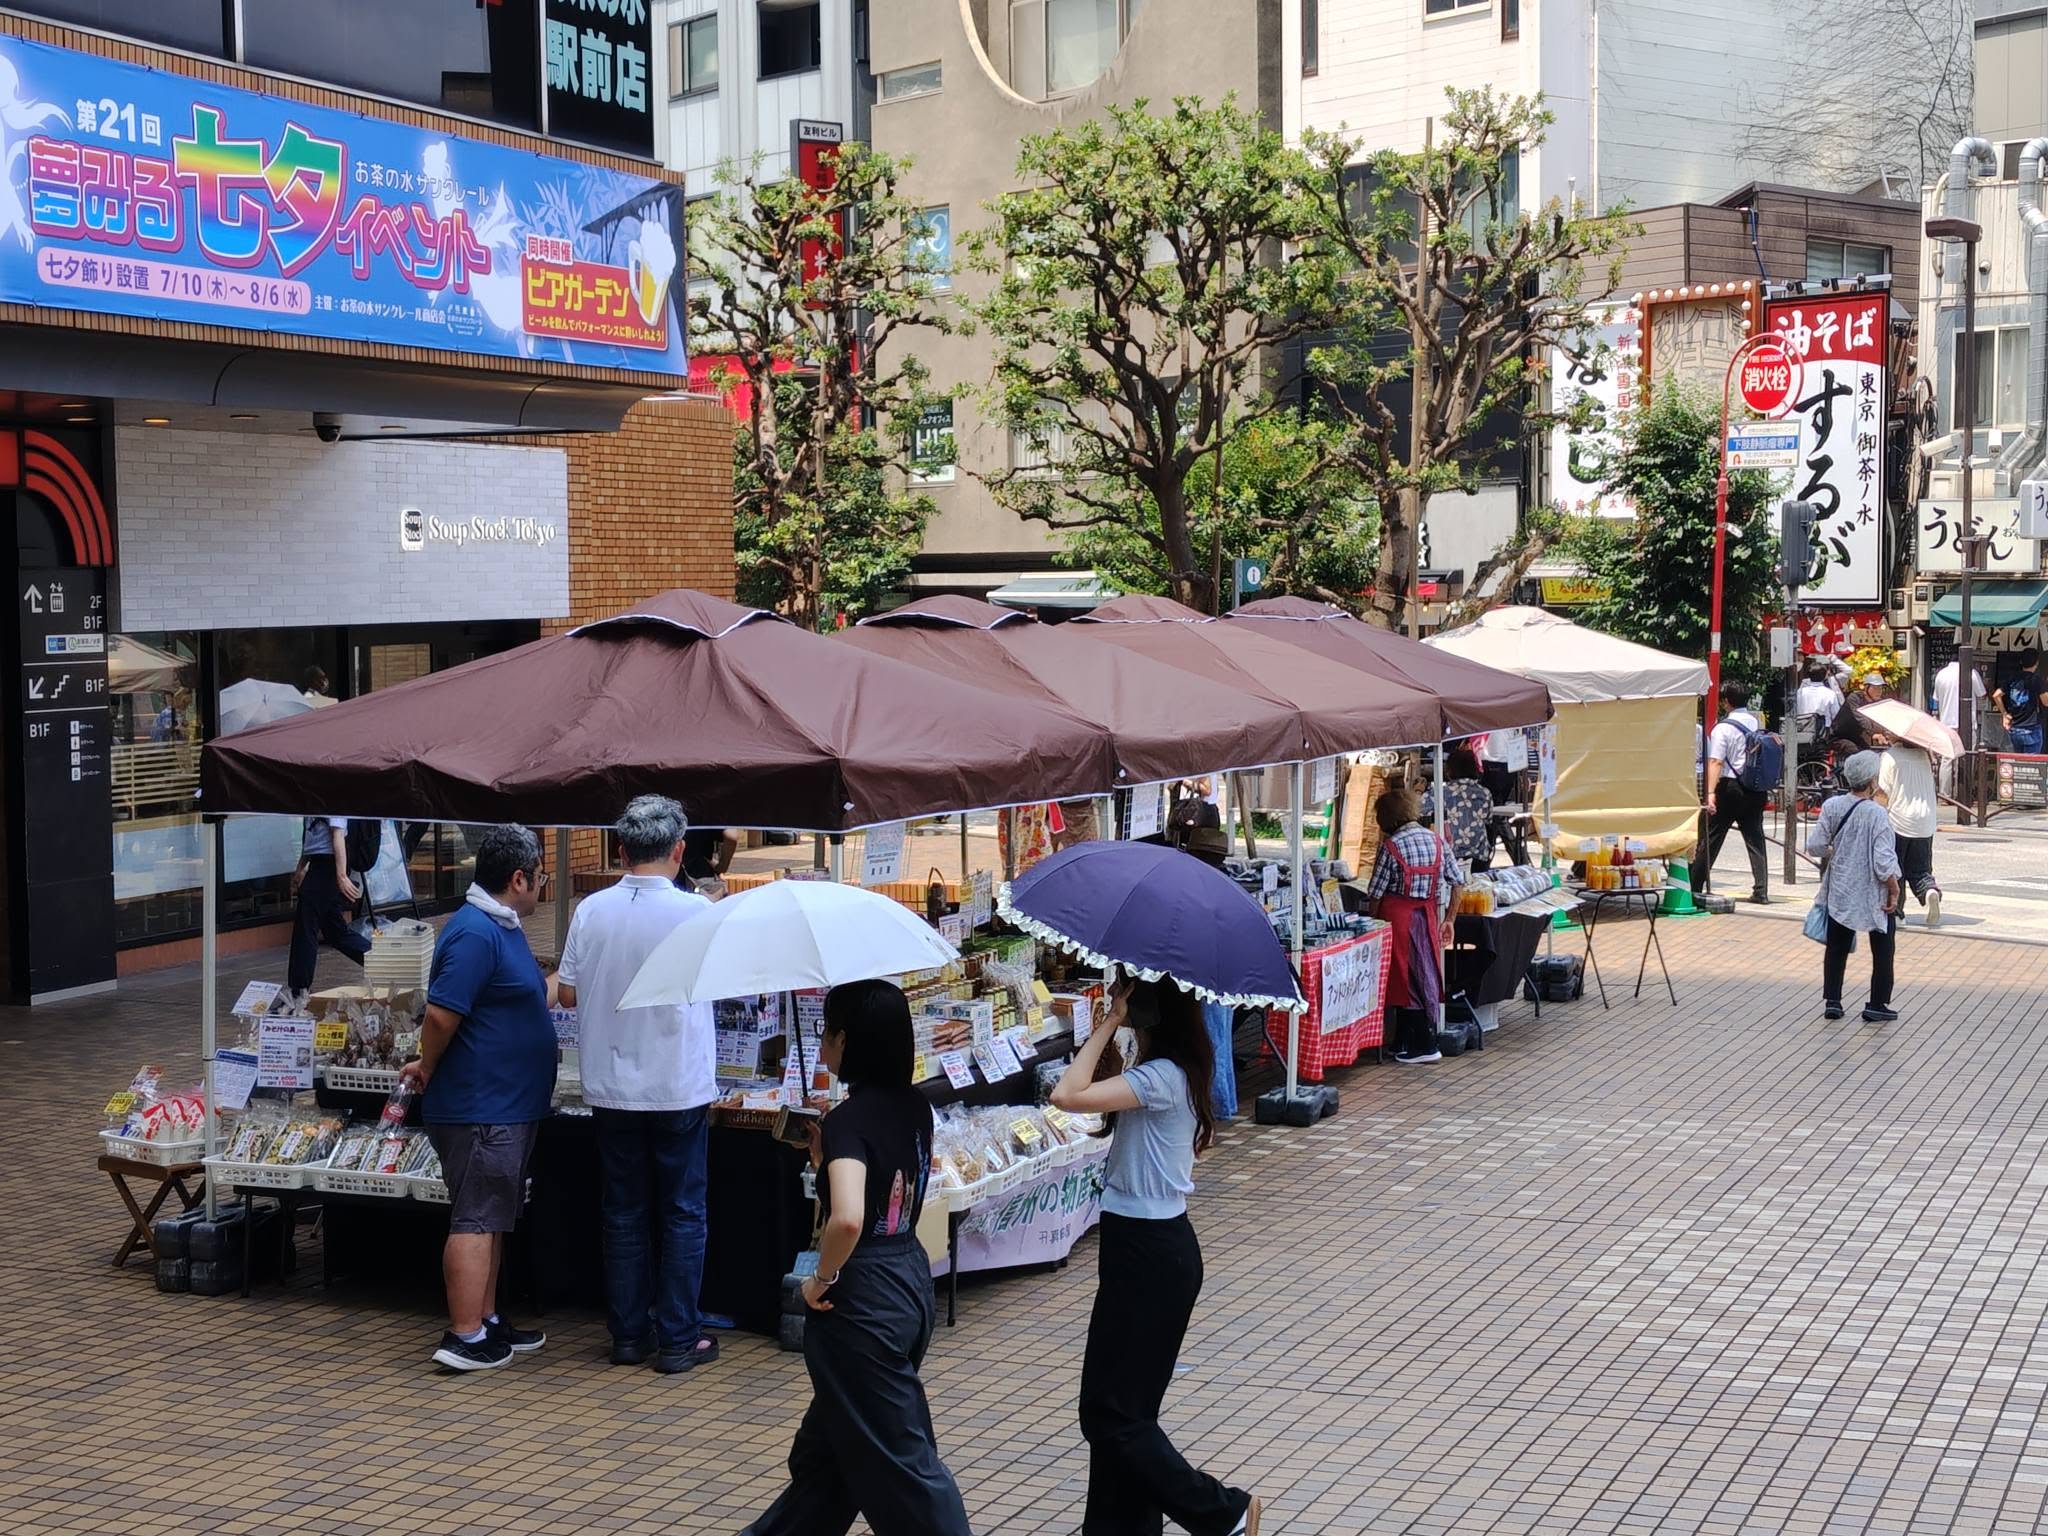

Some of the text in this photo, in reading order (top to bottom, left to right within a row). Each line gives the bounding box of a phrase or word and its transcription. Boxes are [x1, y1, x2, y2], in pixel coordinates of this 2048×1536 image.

[546, 18, 646, 113] 駅前店
[75, 98, 161, 147] 第21回
[803, 126, 837, 138] 友利ビル
[28, 102, 489, 290] 夢みる 七夕 イベント
[355, 161, 489, 206] お茶の水サンクレール
[527, 235, 572, 264] 同時開催
[45, 253, 150, 291] 七夕飾り設置
[527, 266, 630, 319] ビアガーデン
[1773, 307, 1877, 357] 油そば
[1744, 364, 1788, 392] 消火栓
[429, 515, 556, 547] Soup Stock Tokyo
[1924, 507, 2014, 561] うどん
[90, 595, 102, 609] 2F
[83, 616, 102, 630] B1F
[1797, 618, 1856, 653] そば
[85, 679, 104, 693] B1F
[29, 723, 50, 738] B1F
[992, 1157, 1106, 1234] 信州の物産
